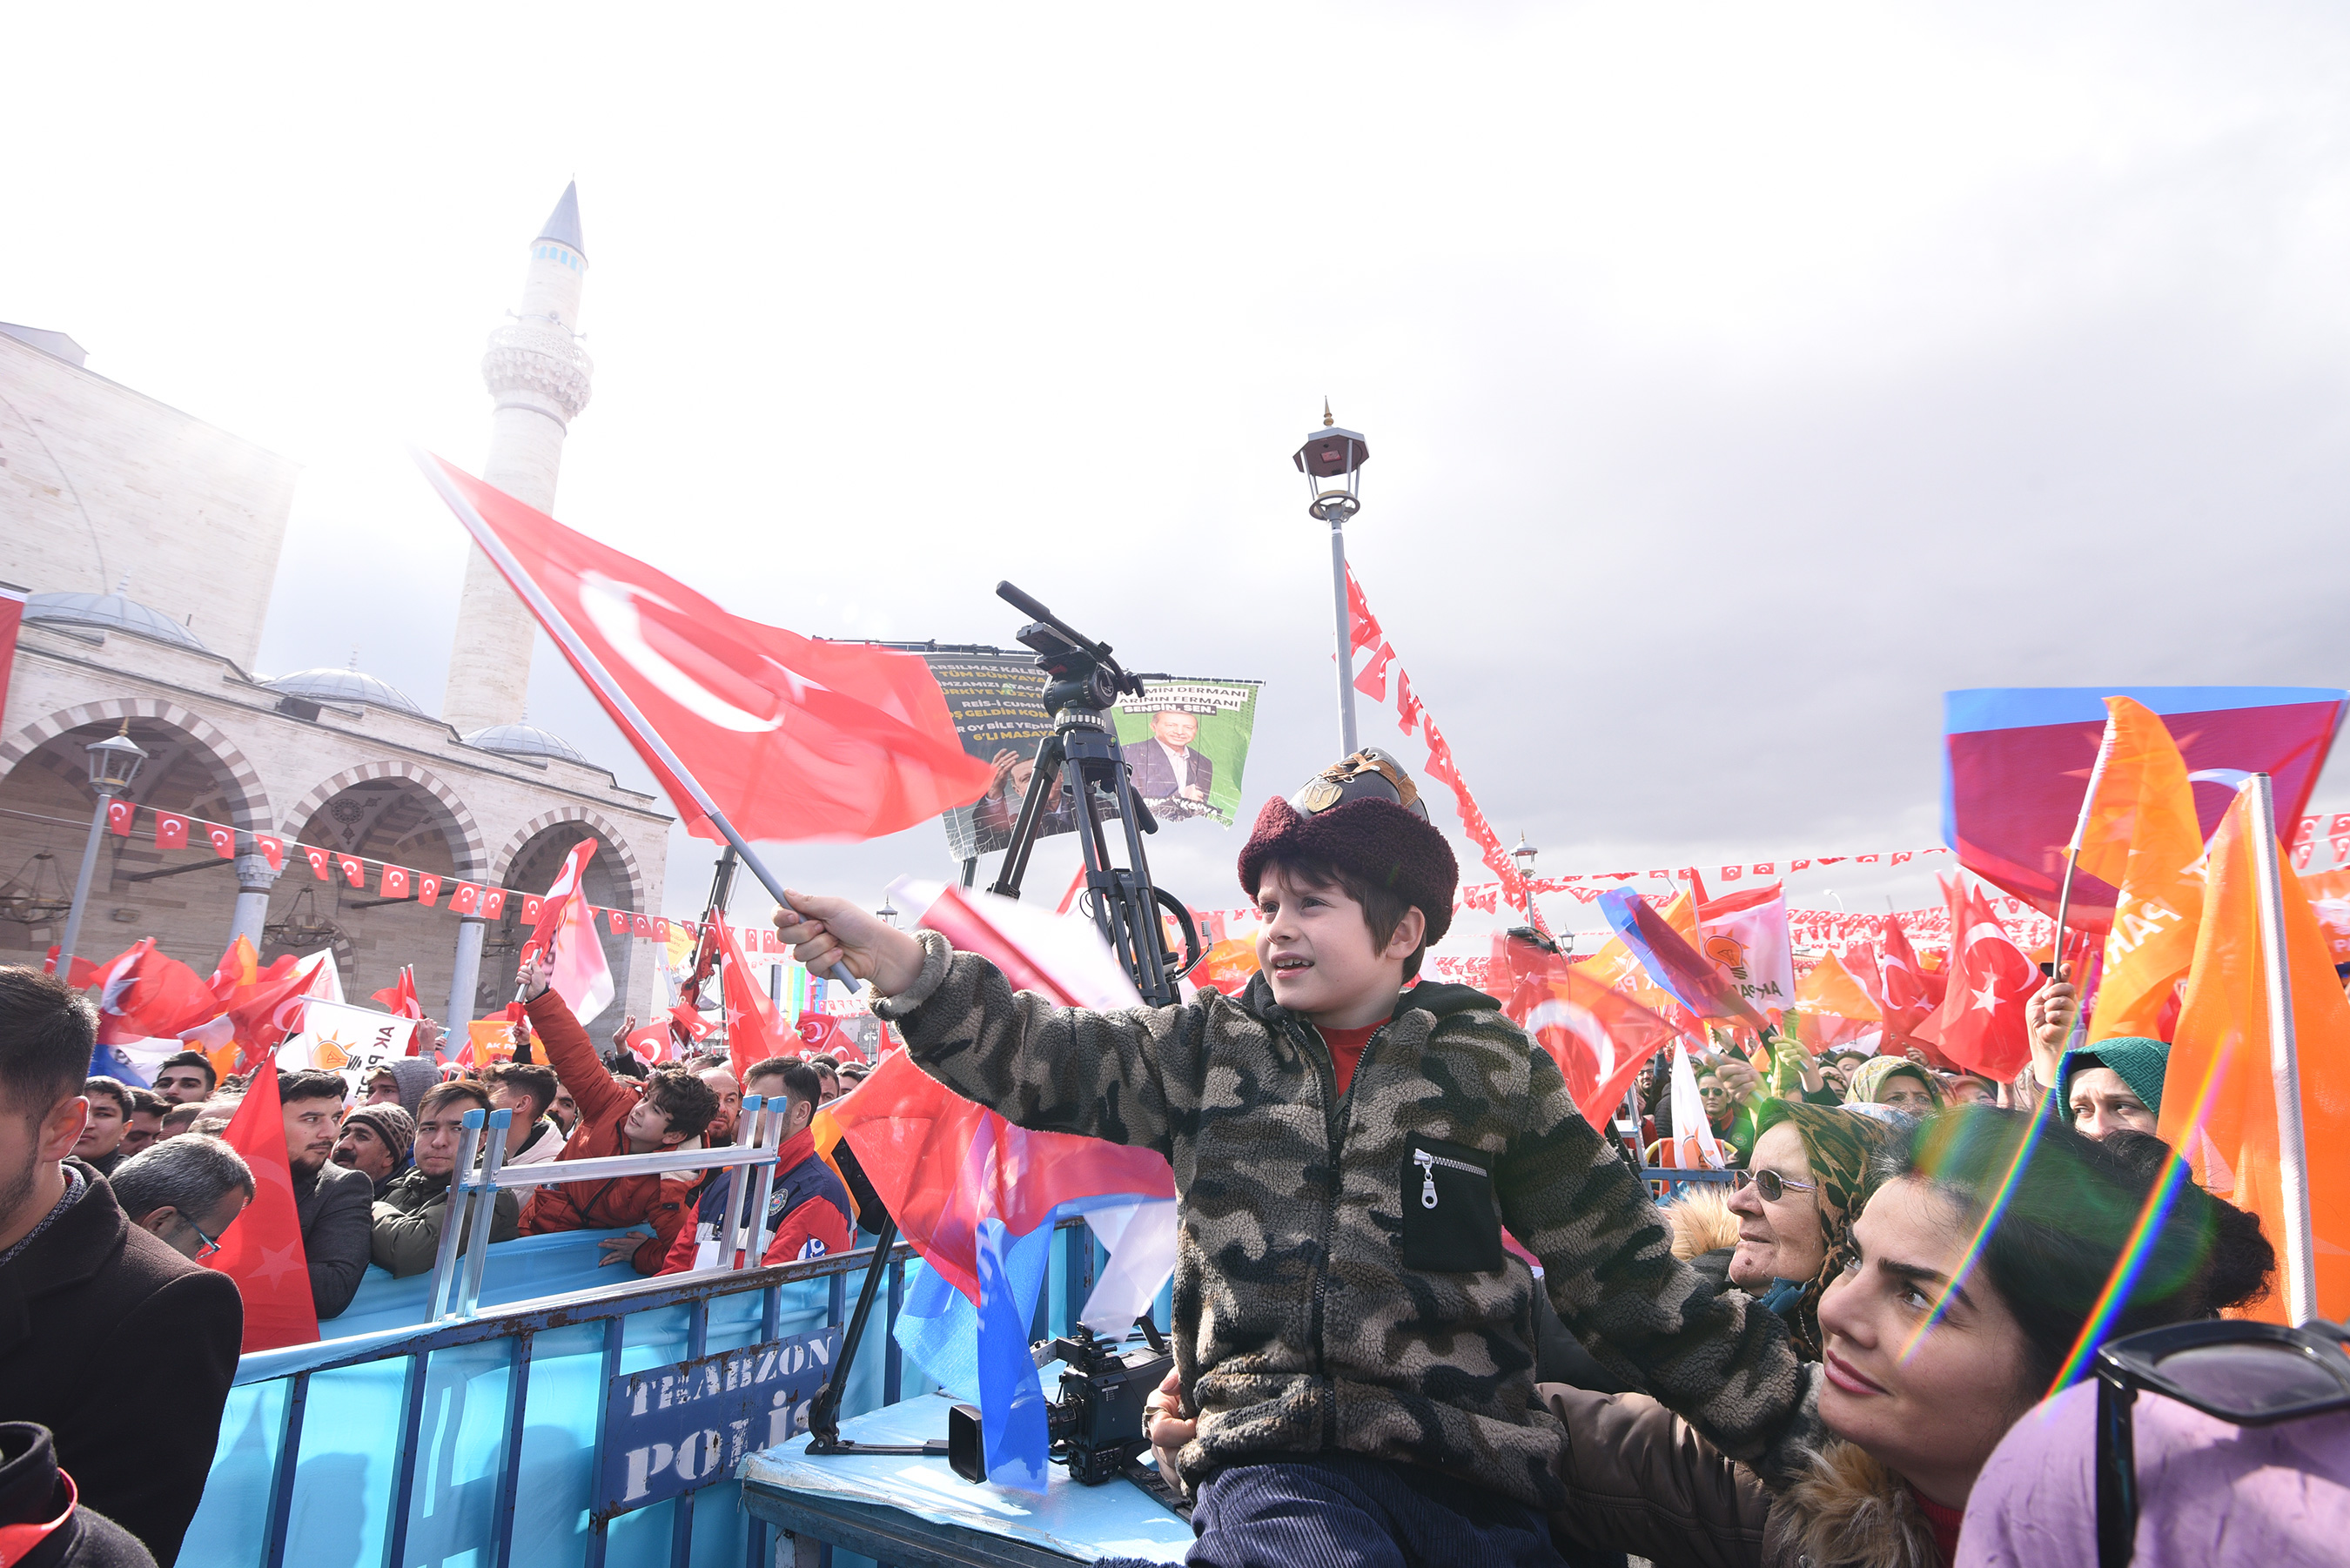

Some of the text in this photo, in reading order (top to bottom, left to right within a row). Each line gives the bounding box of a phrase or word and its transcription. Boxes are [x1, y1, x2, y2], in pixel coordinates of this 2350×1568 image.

[976, 671, 1045, 683] DÜNYAYA
[1002, 682, 1044, 692] ATACA
[996, 689, 1043, 699] YÜZYI
[1173, 697, 1239, 707] FERMANI
[965, 707, 1017, 717] GELDİN
[1018, 709, 1050, 718] KON
[1016, 721, 1055, 730] YEDİR
